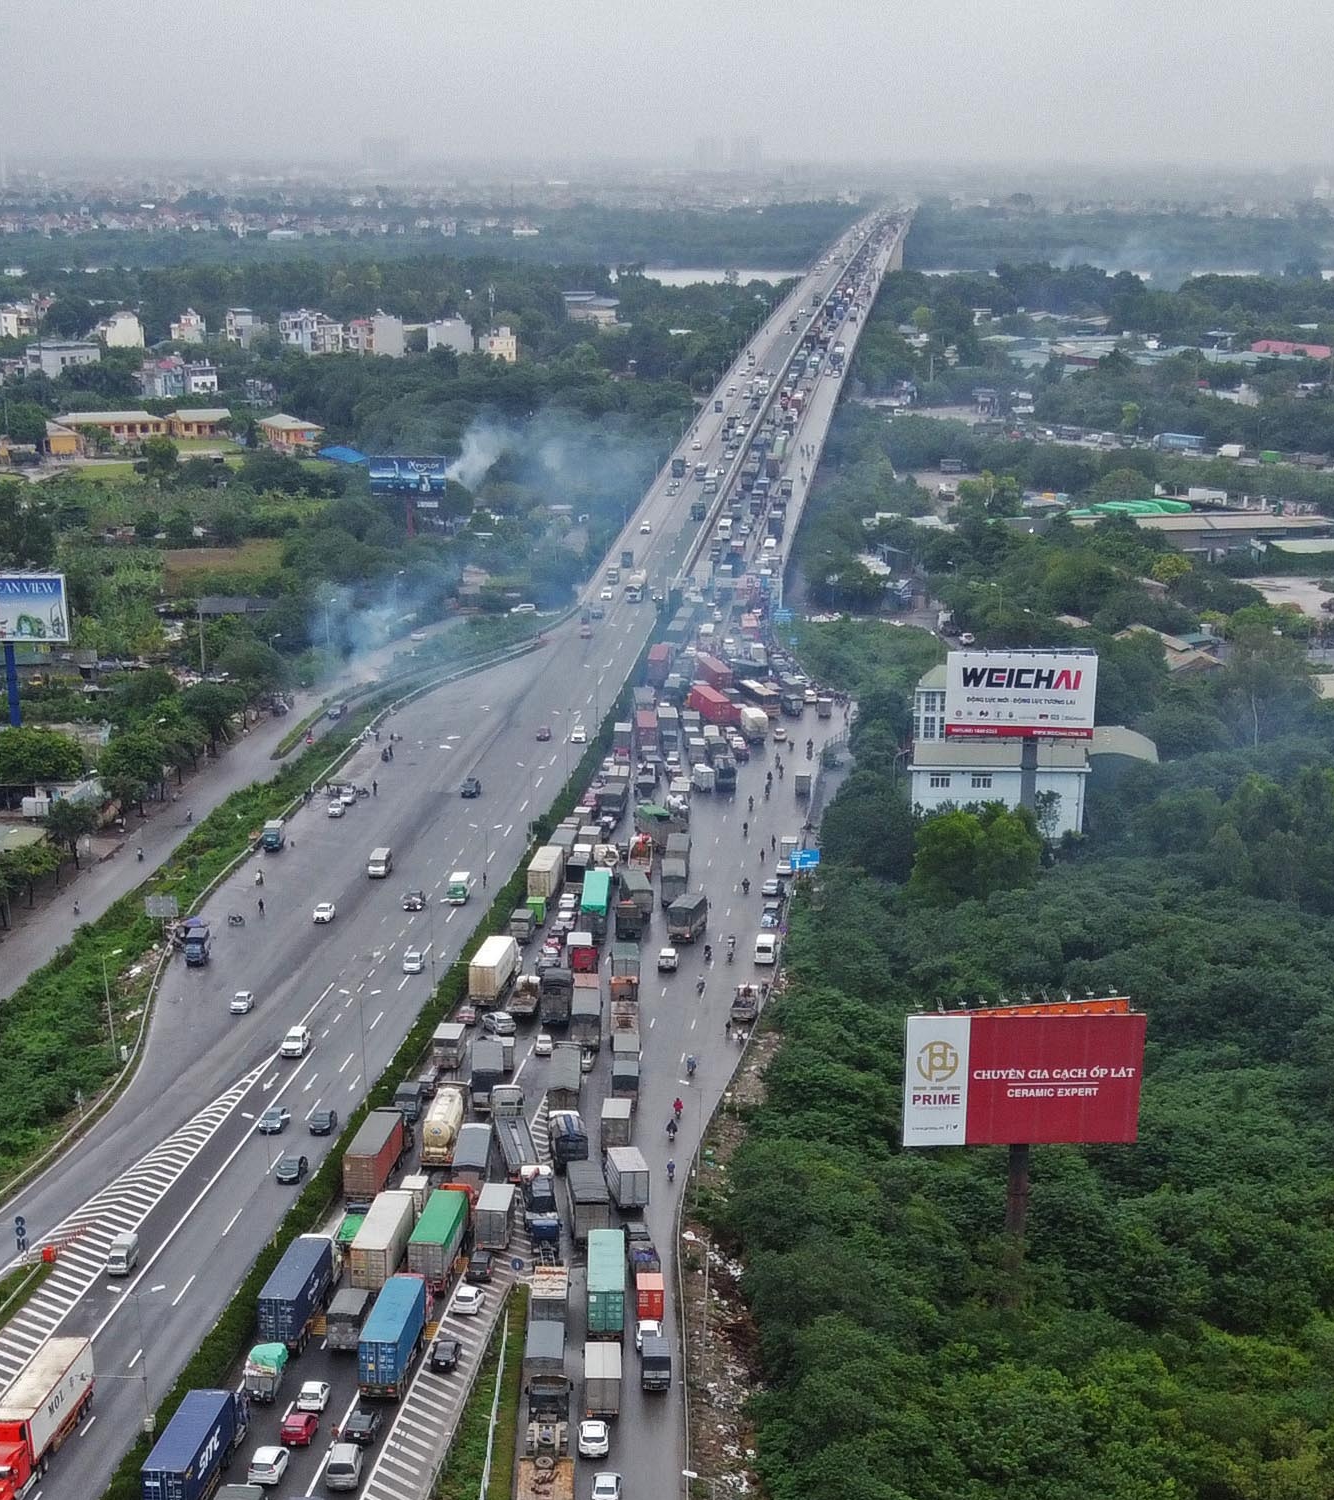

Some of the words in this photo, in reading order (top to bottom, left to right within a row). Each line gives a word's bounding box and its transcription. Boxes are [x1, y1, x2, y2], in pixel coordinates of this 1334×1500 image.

[21, 582, 55, 594] VIEW
[962, 667, 1082, 690] WEICHAI
[973, 1068, 1025, 1080] CHUYÊN
[1028, 1070, 1049, 1080] GIA
[1052, 1069, 1087, 1081] GẠCH
[1090, 1065, 1108, 1078] ỐP
[1111, 1066, 1136, 1078] LÁT
[912, 1094, 961, 1105] PRIME
[1007, 1088, 1054, 1098] CERAMIC
[1057, 1087, 1098, 1097] EXPERT
[48, 1390, 65, 1416] MOL
